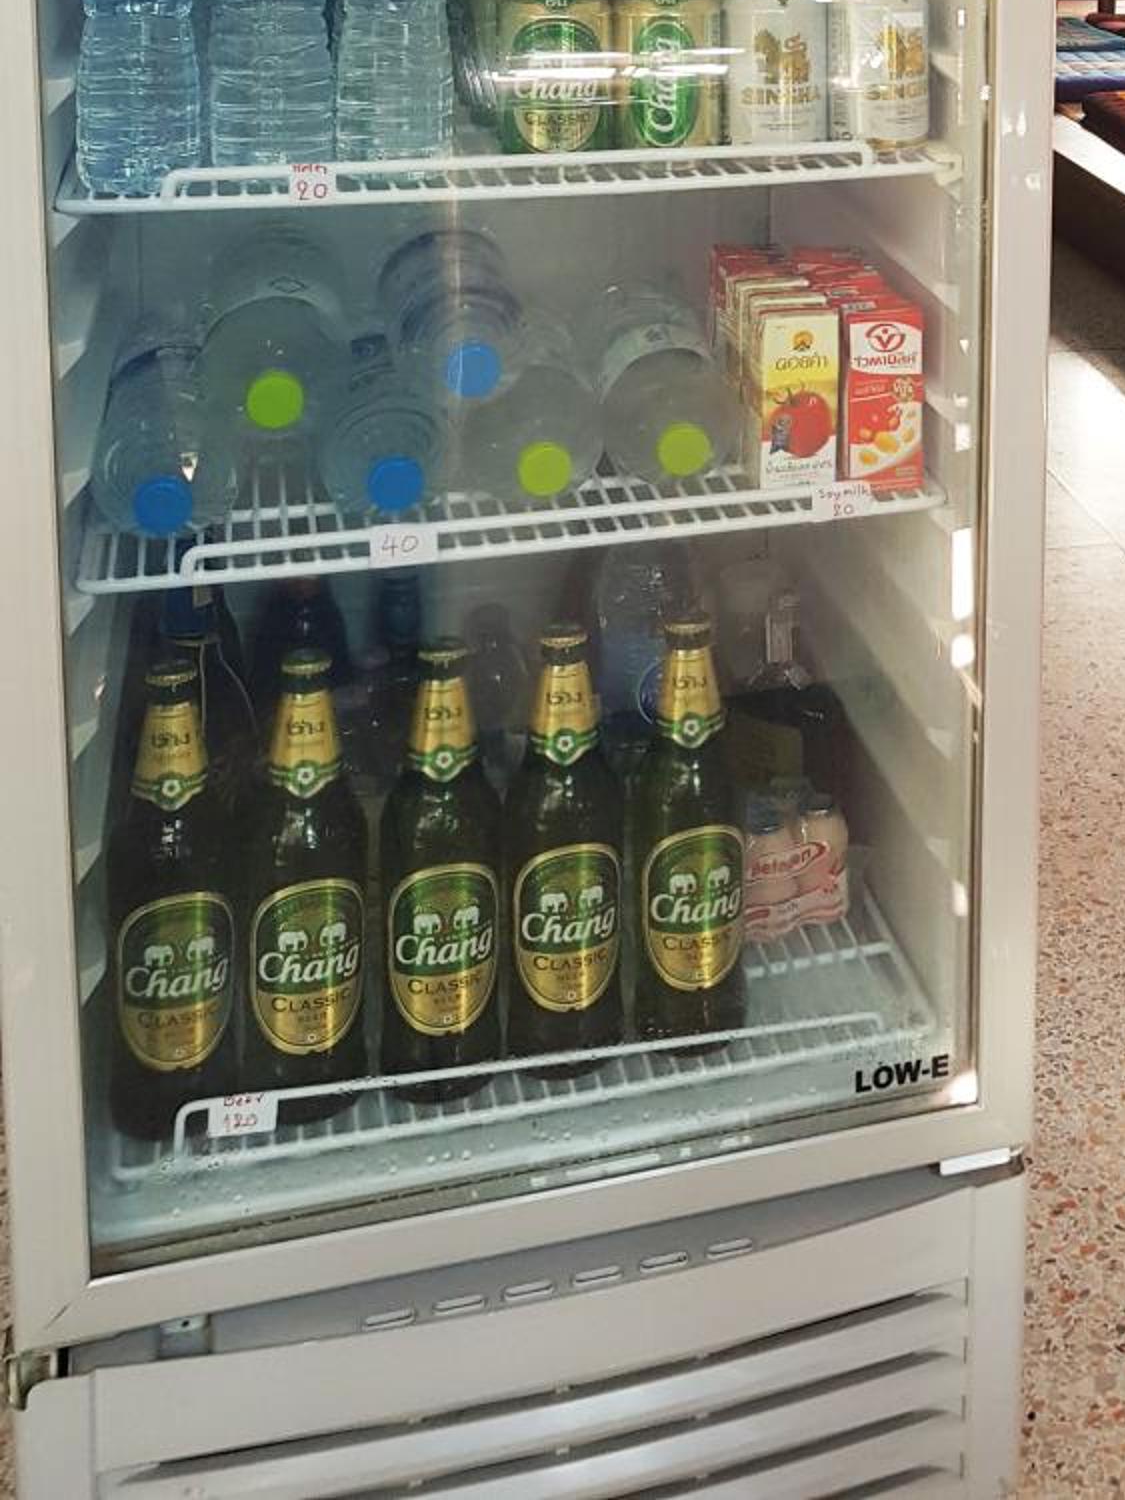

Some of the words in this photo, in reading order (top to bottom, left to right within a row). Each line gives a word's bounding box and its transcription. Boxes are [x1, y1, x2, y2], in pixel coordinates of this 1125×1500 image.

[381, 533, 418, 557] 40
[521, 904, 616, 944] Chang
[650, 884, 742, 925] Chang
[258, 943, 359, 984] Chang
[395, 923, 494, 966] Chang
[533, 948, 608, 972] CLASSIC
[126, 955, 228, 998] Chang
[271, 988, 350, 1013] CLASSIC
[855, 1054, 949, 1093] LOW-E
